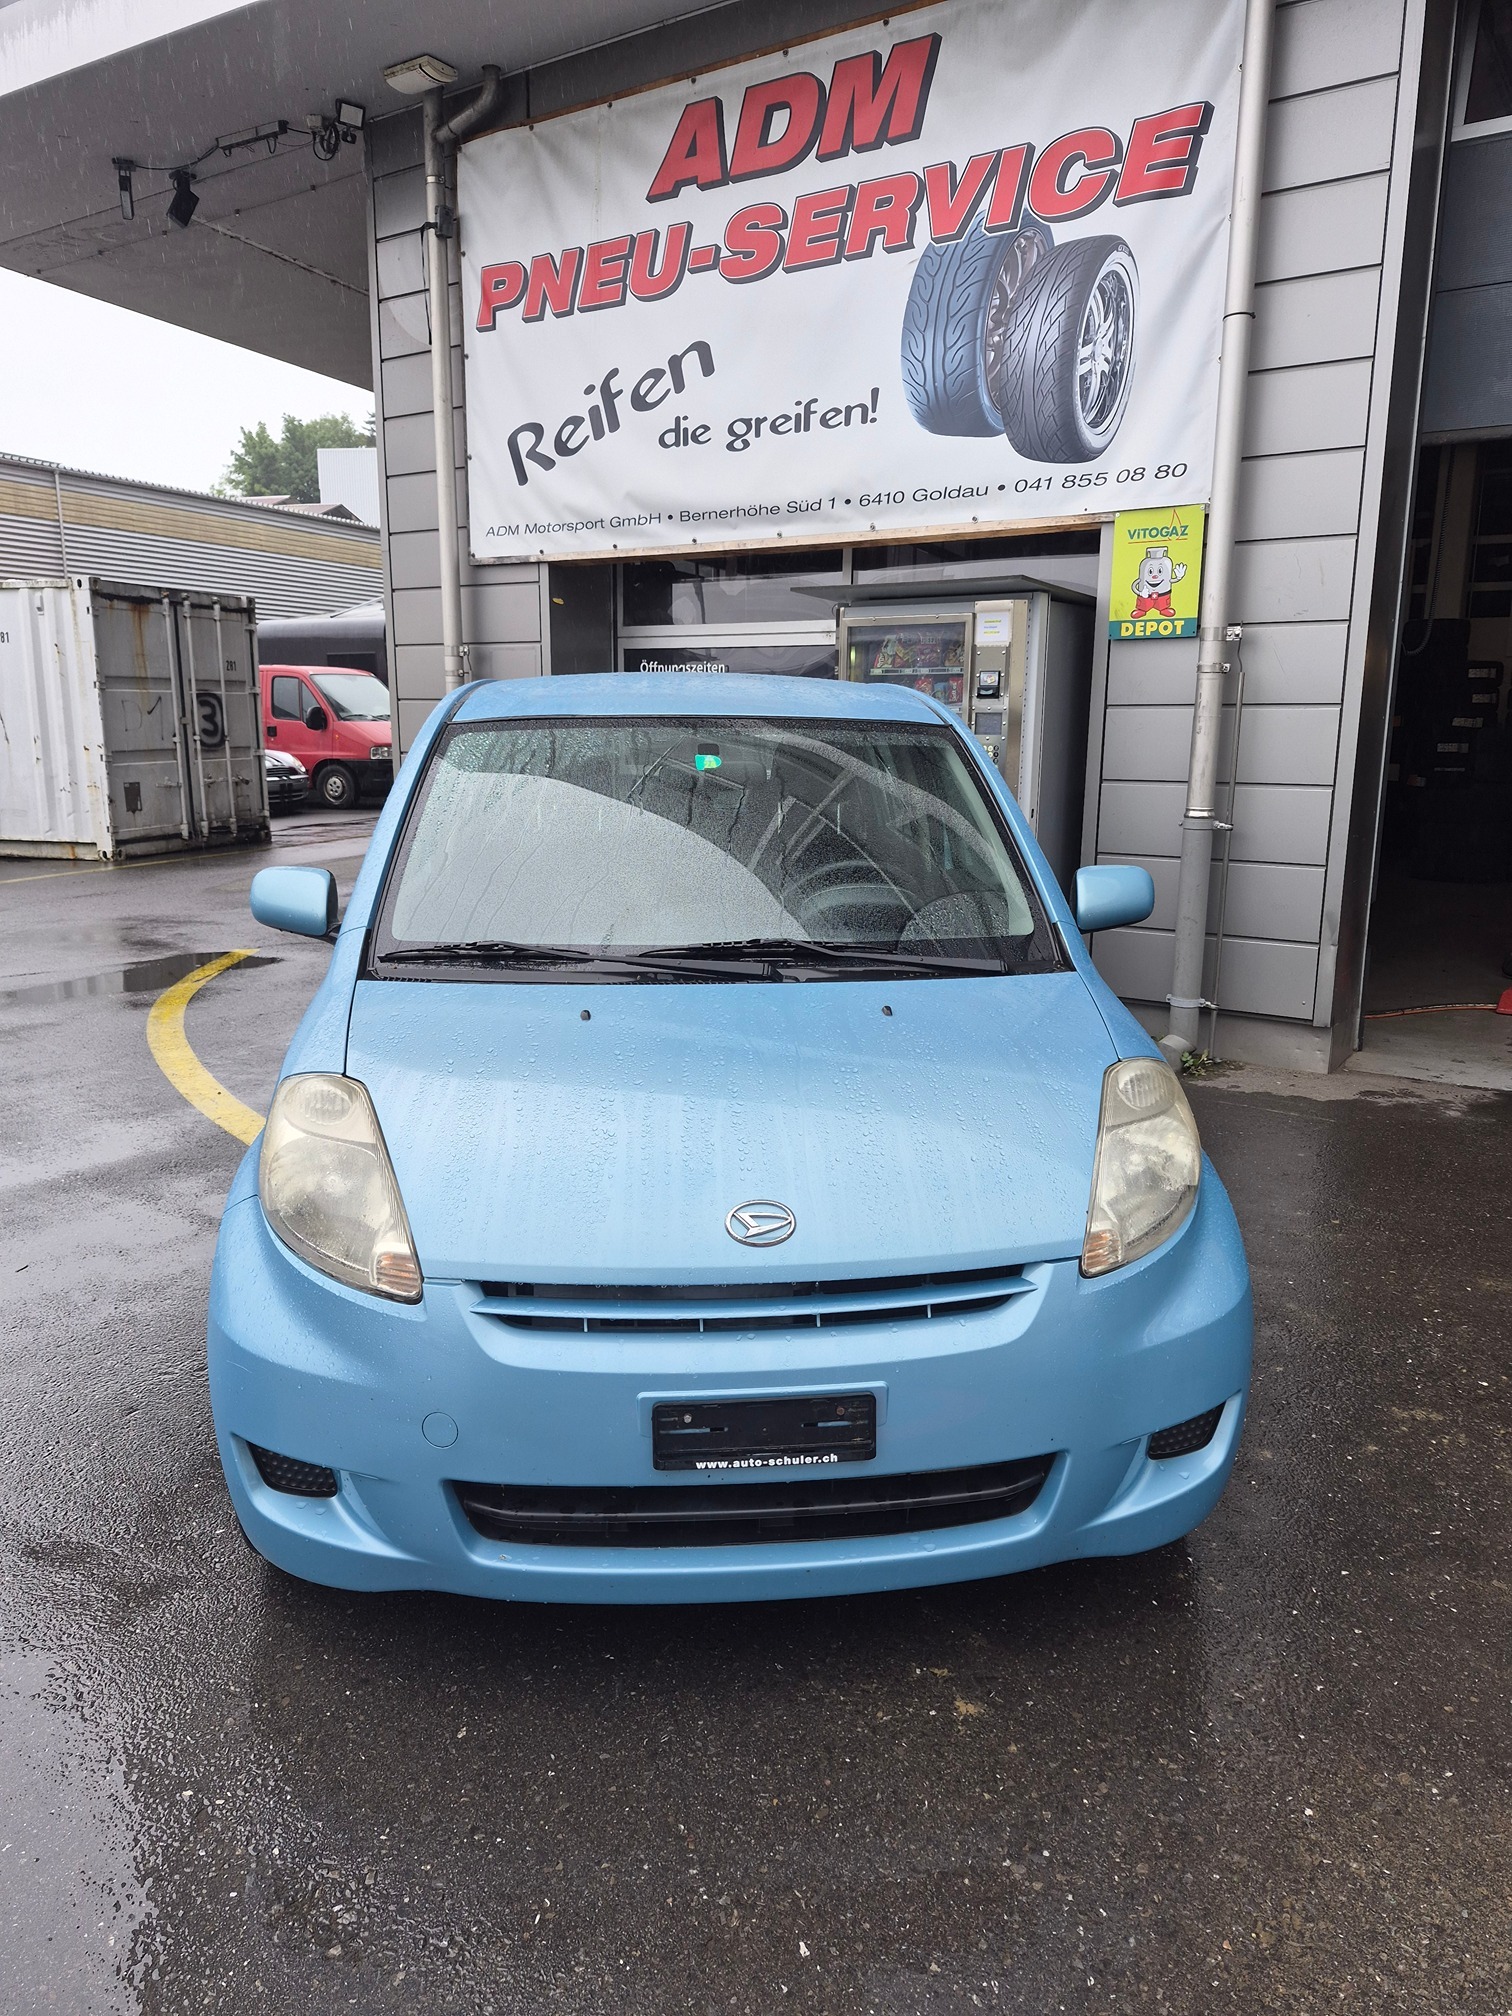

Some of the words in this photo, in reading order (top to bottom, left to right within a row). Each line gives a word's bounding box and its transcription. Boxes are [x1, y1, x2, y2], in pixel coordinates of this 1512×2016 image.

[646, 32, 942, 203] ADM
[476, 100, 1212, 333] PNEU-SERVICE
[507, 340, 714, 487] Reifen
[658, 415, 712, 450] die
[726, 387, 880, 453] greifen!
[485, 524, 520, 538] ADM
[523, 517, 606, 535] Motorsport
[609, 512, 662, 529] GmbH
[679, 504, 782, 523] Bernerhöhe
[786, 498, 822, 514] Süd
[828, 496, 837, 510] 1
[859, 490, 905, 507] 6410
[912, 484, 989, 503] Goldau
[1014, 476, 1053, 493] 041
[1061, 471, 1108, 490] 855
[1116, 466, 1146, 484] 08
[1154, 462, 1188, 480] 80
[1120, 619, 1185, 637] DEPOT
[226, 660, 237, 671] 281
[199, 699, 219, 737] 3
[696, 1454, 838, 1469] www.auto-schuler.ch
